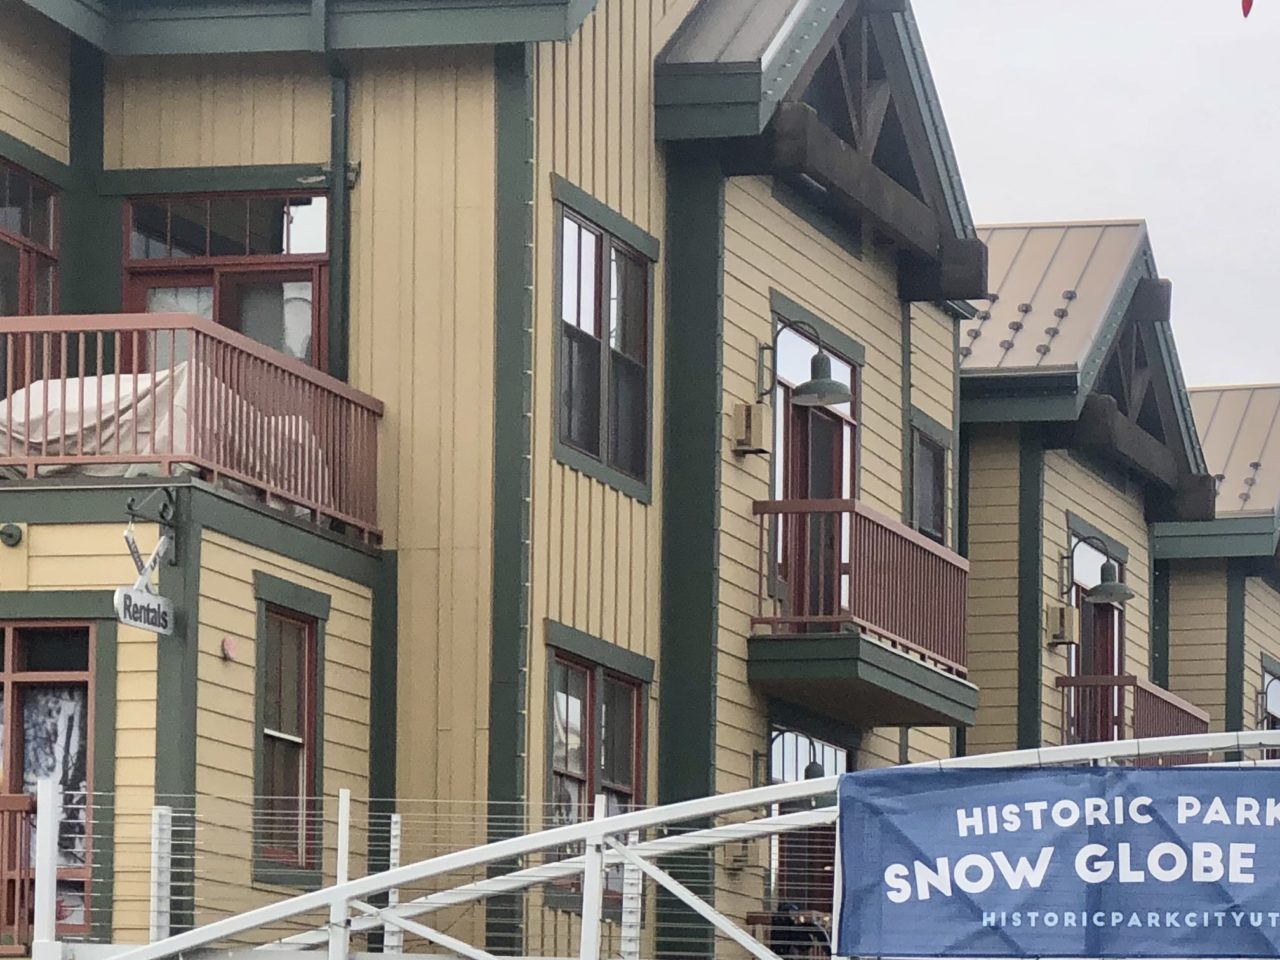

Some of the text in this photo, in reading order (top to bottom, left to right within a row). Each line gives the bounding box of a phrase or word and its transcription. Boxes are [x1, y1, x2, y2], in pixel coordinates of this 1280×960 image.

[123, 593, 169, 630] Rentals
[956, 796, 1154, 837] HISTORIC
[884, 846, 1056, 904] SNOW
[1074, 841, 1257, 885] GLOBE
